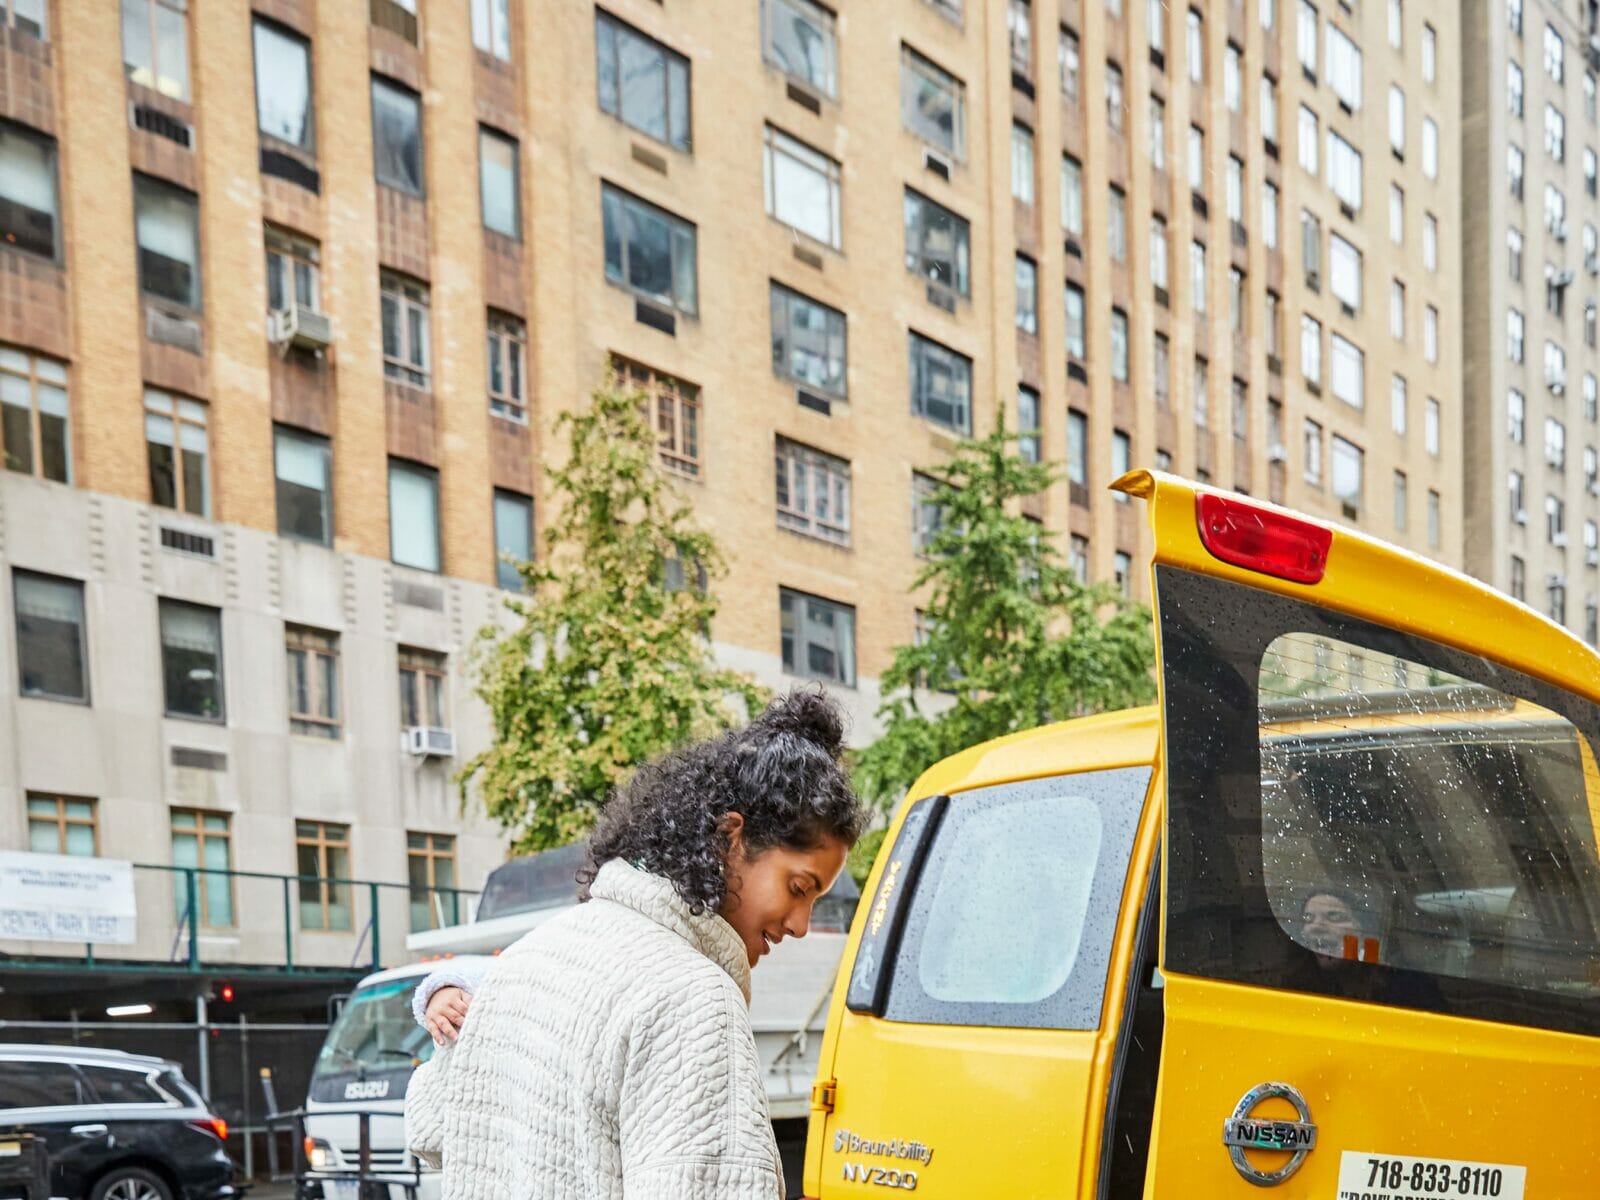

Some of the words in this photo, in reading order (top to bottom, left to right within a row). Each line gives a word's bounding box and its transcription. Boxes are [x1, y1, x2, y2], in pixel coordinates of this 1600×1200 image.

[871, 861, 901, 935] VACANT
[344, 1080, 390, 1099] ISUZU
[1237, 1124, 1312, 1145] NISSAN
[850, 1135, 933, 1166] BraunAbility
[843, 1162, 918, 1191] NV200
[1367, 1158, 1503, 1198] 718-833-8110
